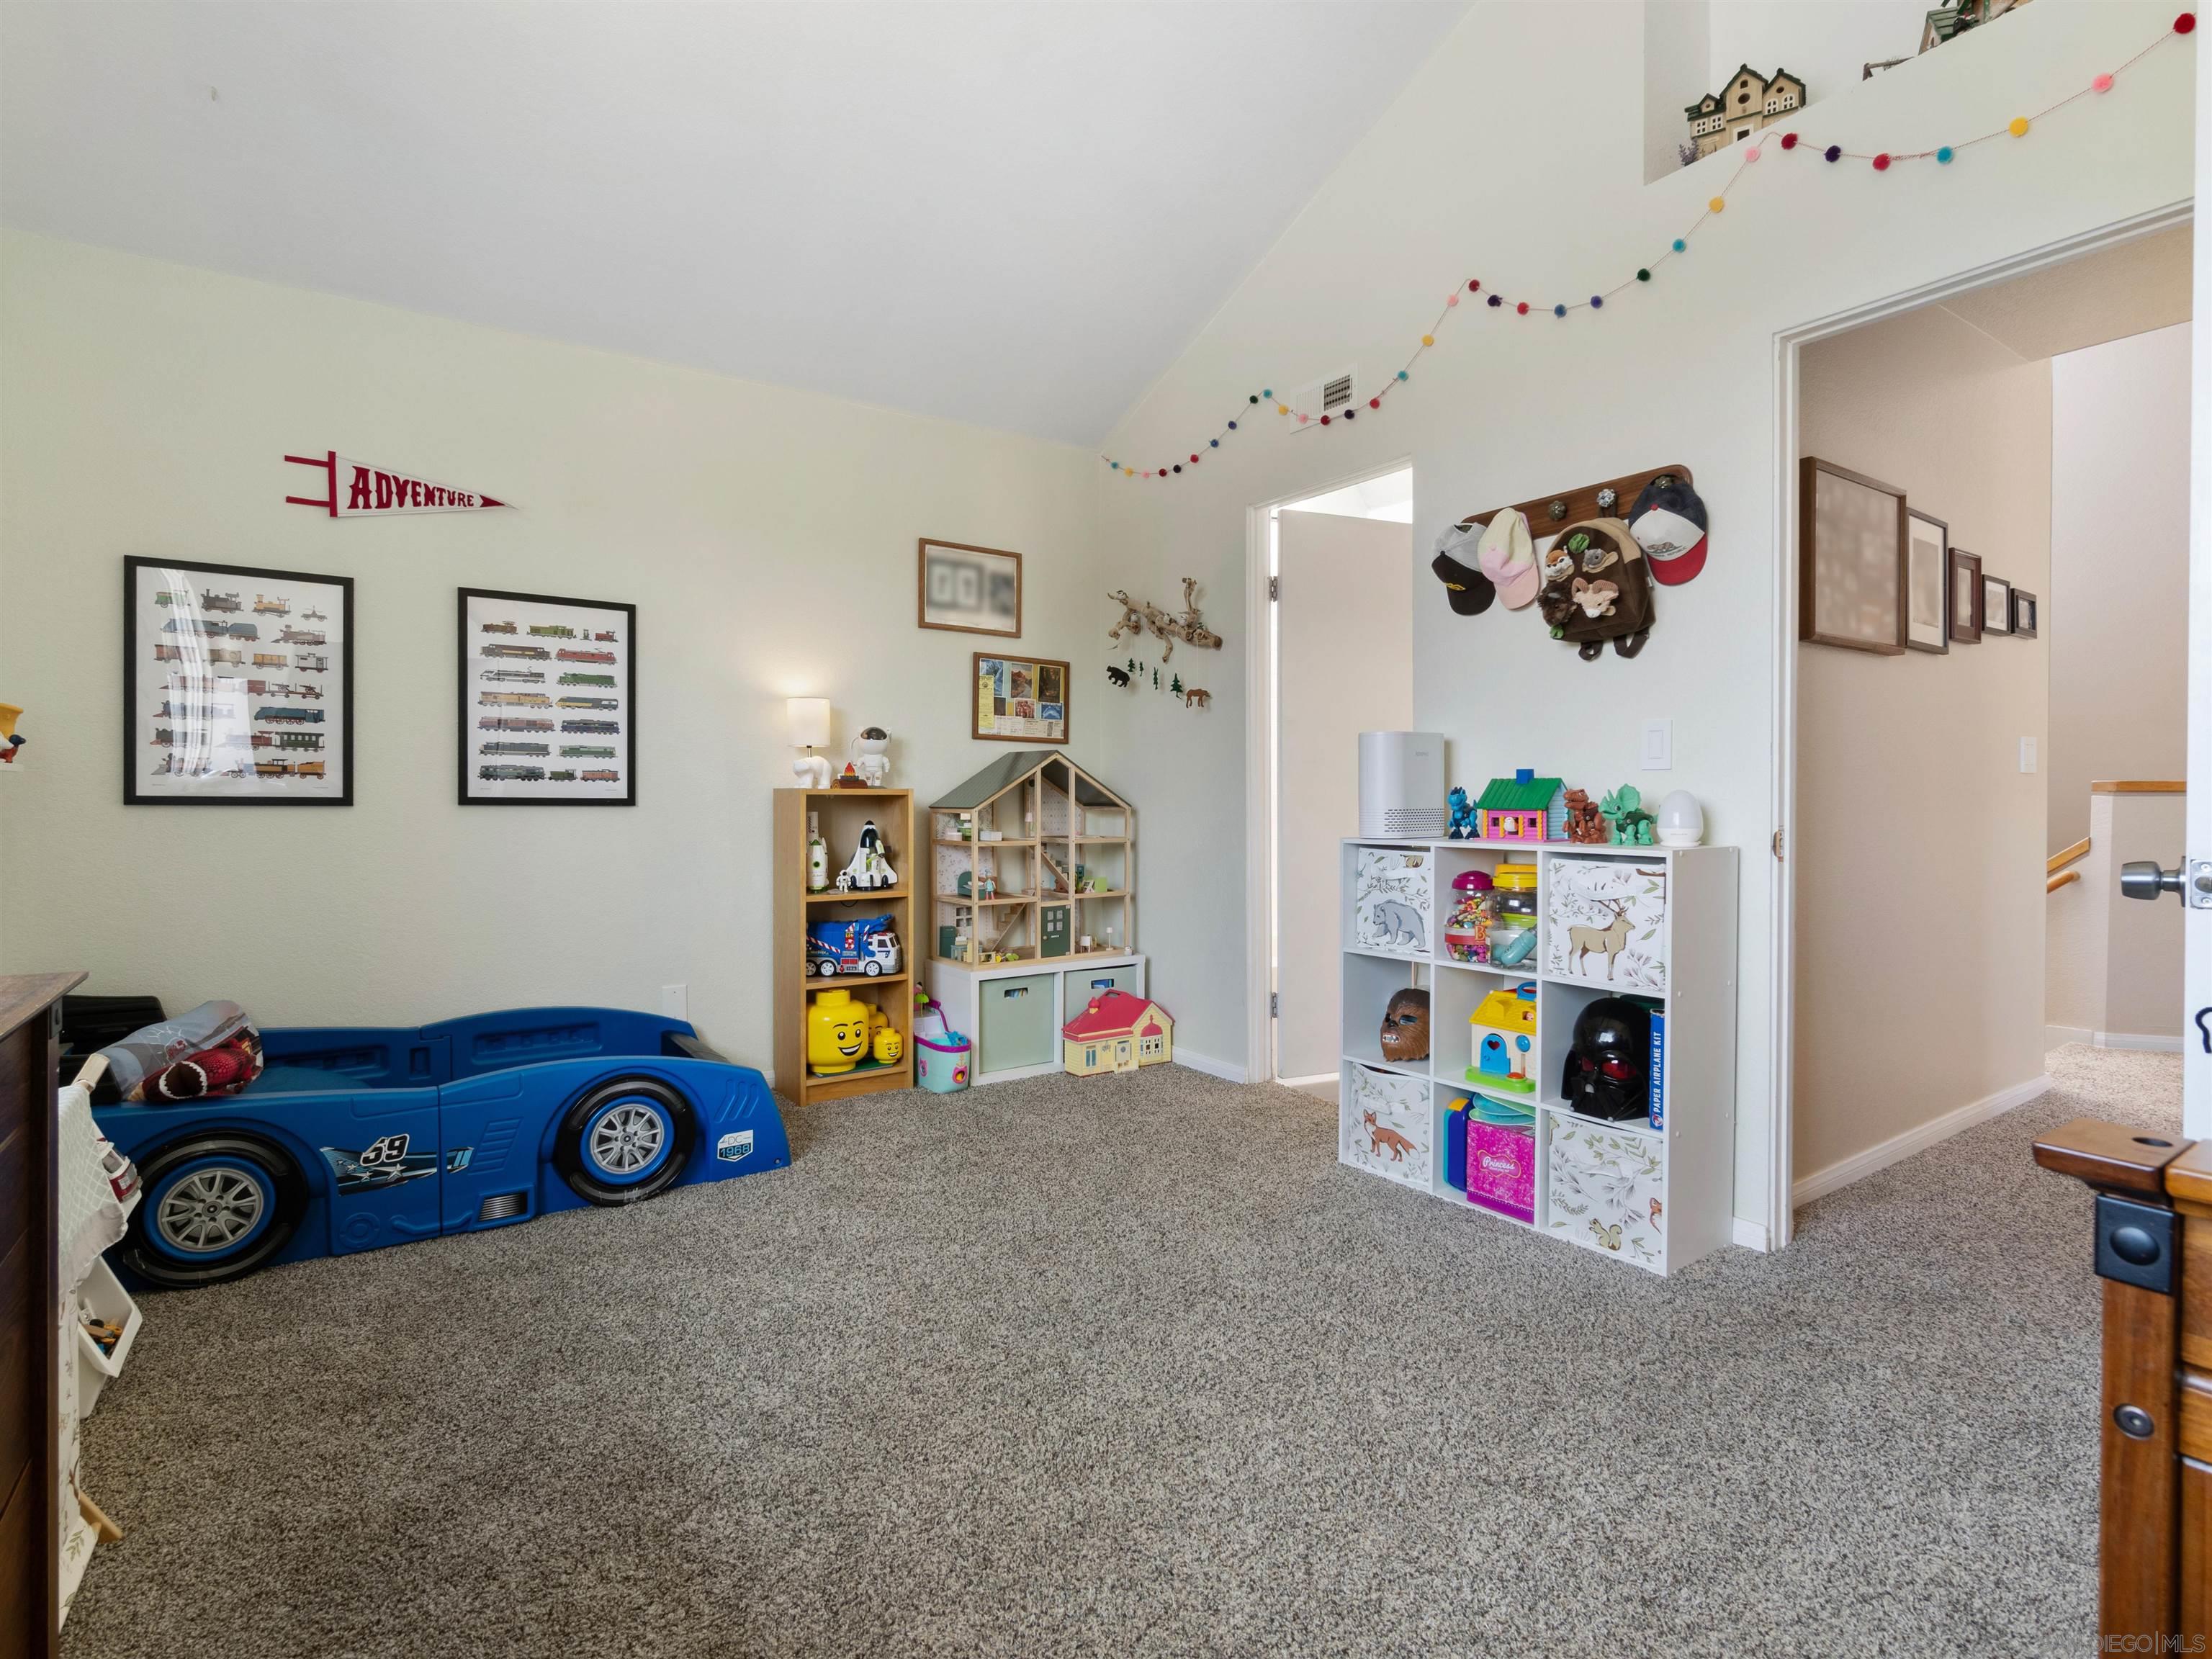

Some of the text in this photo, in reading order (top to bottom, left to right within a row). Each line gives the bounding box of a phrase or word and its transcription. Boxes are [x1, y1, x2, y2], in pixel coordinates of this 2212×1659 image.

[346, 465, 475, 510] ADVENTURE
[1653, 1031, 1662, 1112] PAPER AIRPLANE KIT
[360, 1133, 410, 1166] 59
[720, 1143, 750, 1158] 1968
[727, 1135, 743, 1146] DC
